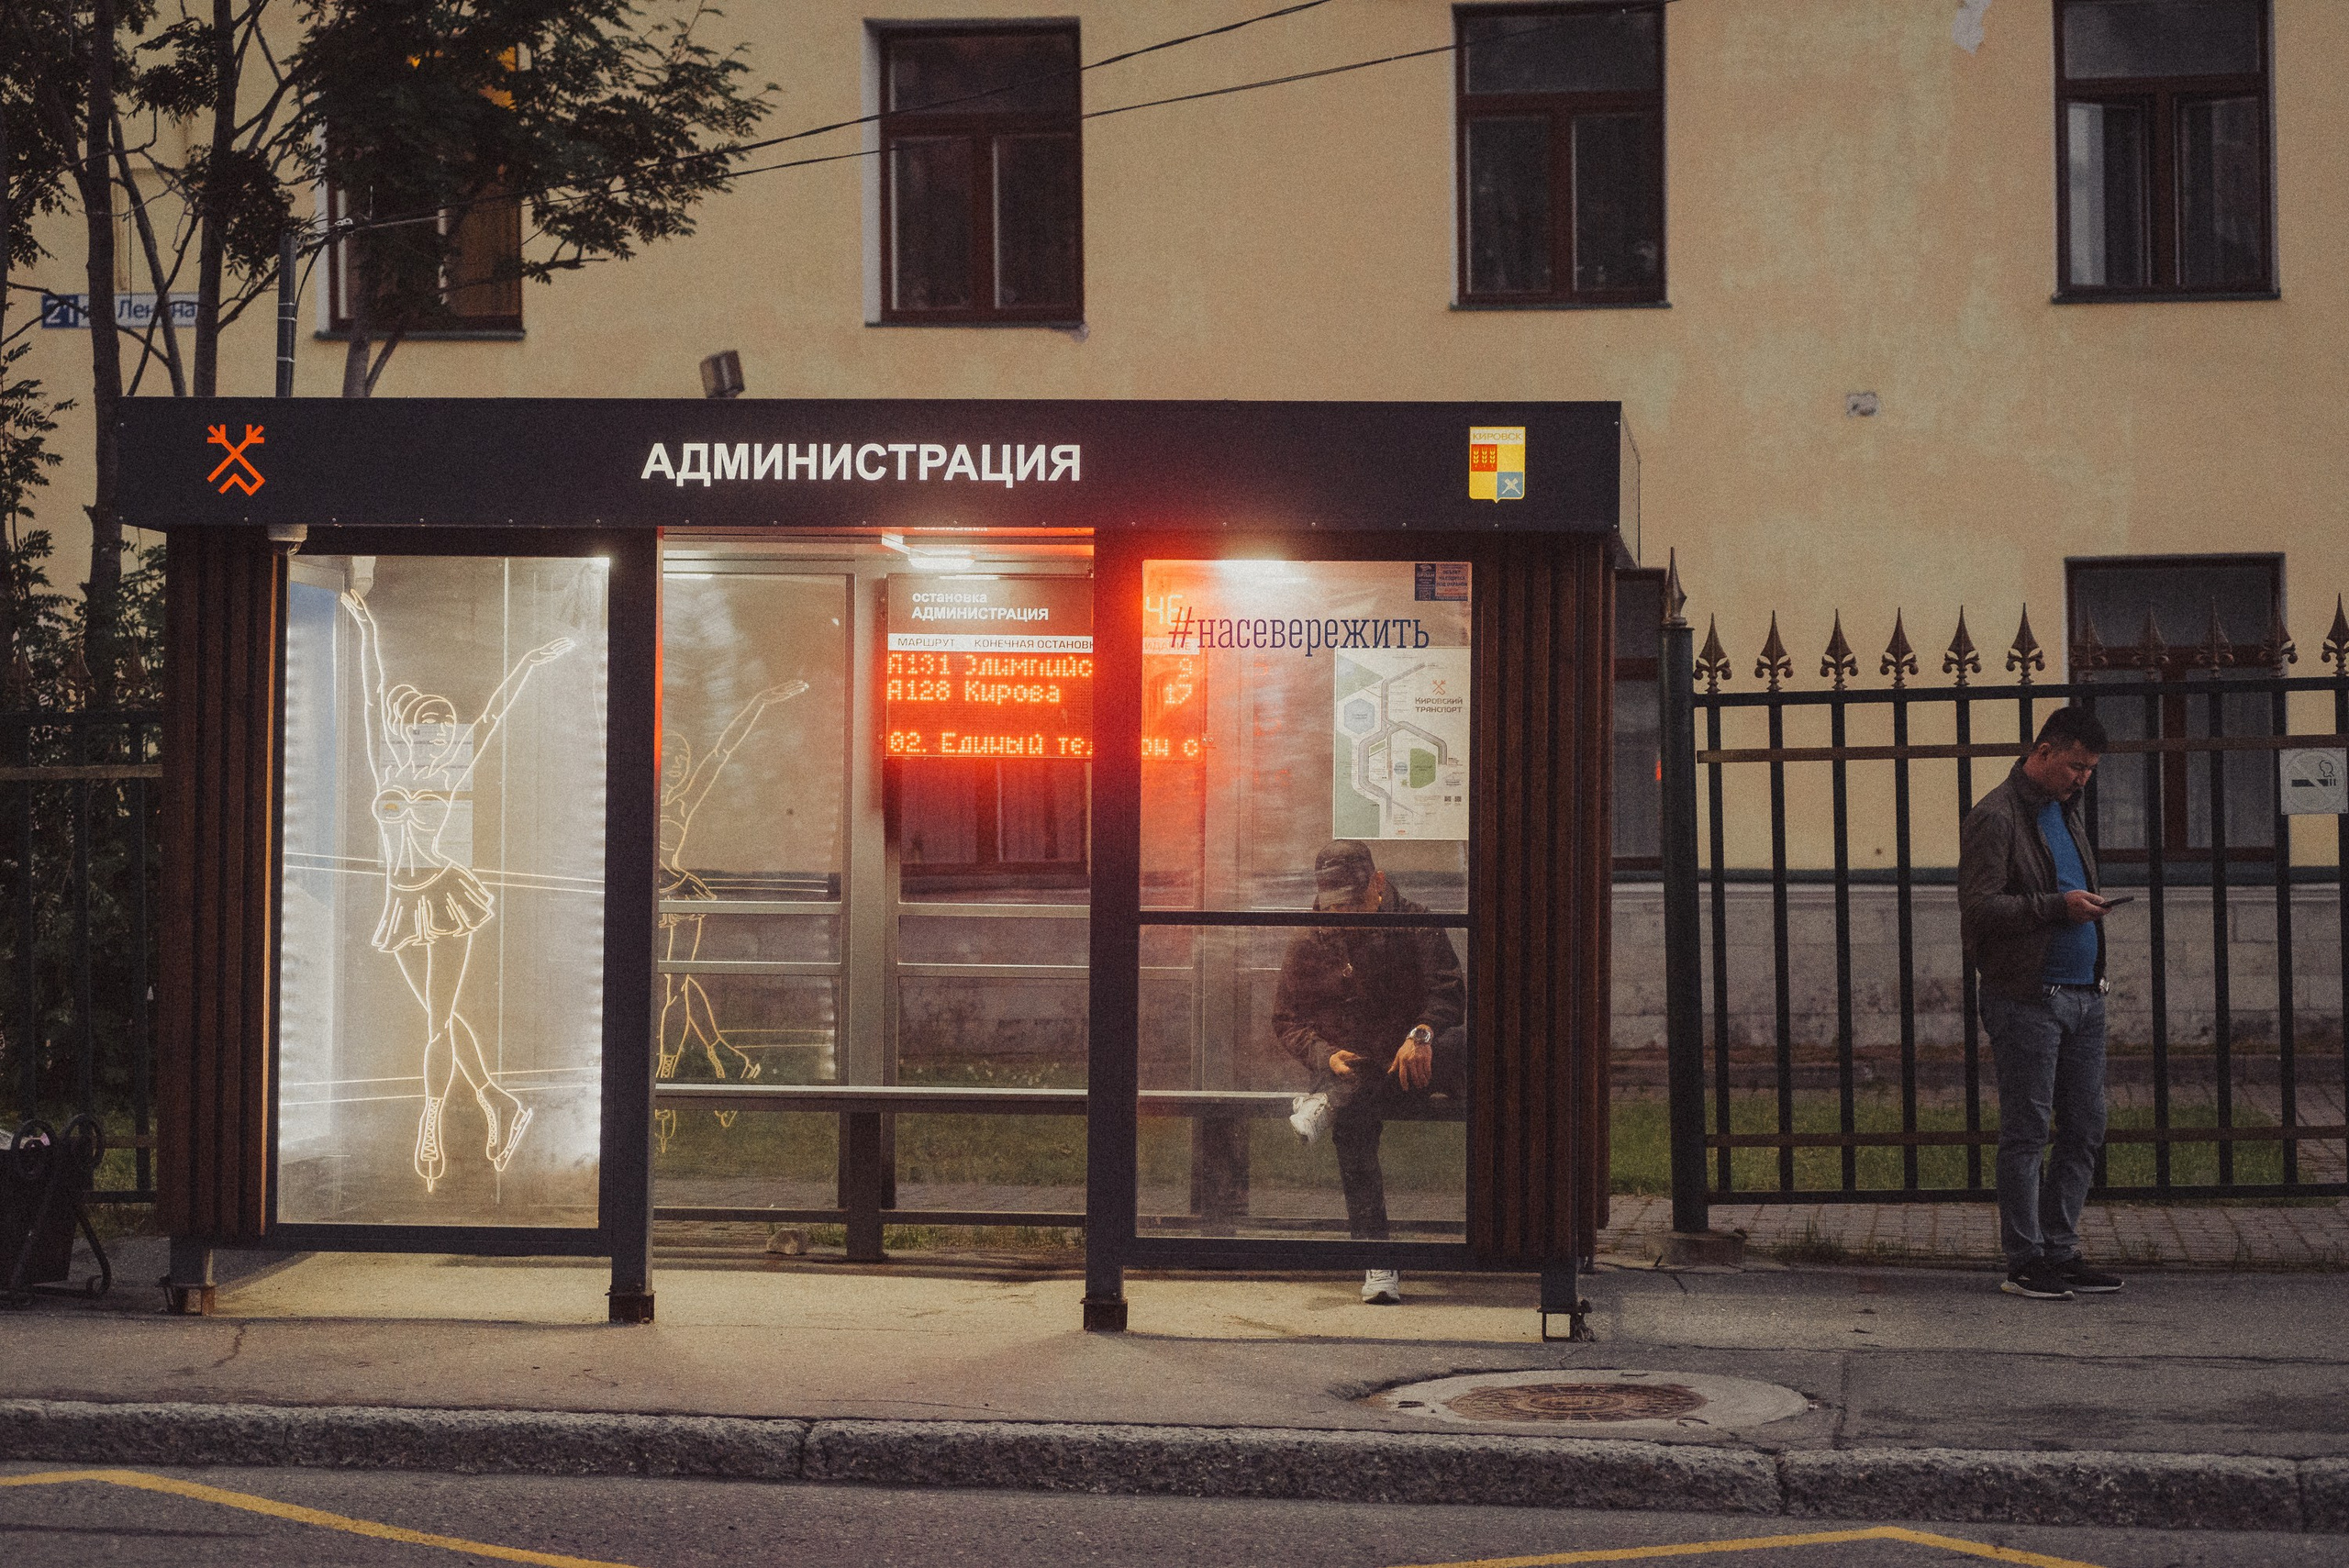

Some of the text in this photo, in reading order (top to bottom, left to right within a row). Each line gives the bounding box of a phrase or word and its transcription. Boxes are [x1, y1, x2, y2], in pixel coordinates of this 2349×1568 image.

[46, 299, 74, 324] 21
[118, 299, 196, 319] Ленна
[1472, 432, 1522, 440] КИРОВСК
[640, 442, 1081, 488] АДМИНИСТРАЦИЯ
[911, 592, 988, 604] остановка
[911, 606, 1049, 622] АДМИНИСТРАЦИЯ
[1168, 606, 1431, 657] #насевережить
[897, 637, 955, 648] МАРШРУТ
[974, 638, 1035, 649] КОНЕЧНАЯ
[887, 680, 951, 700] А128
[965, 680, 1061, 705] Кирова
[941, 732, 1043, 754] Единый
